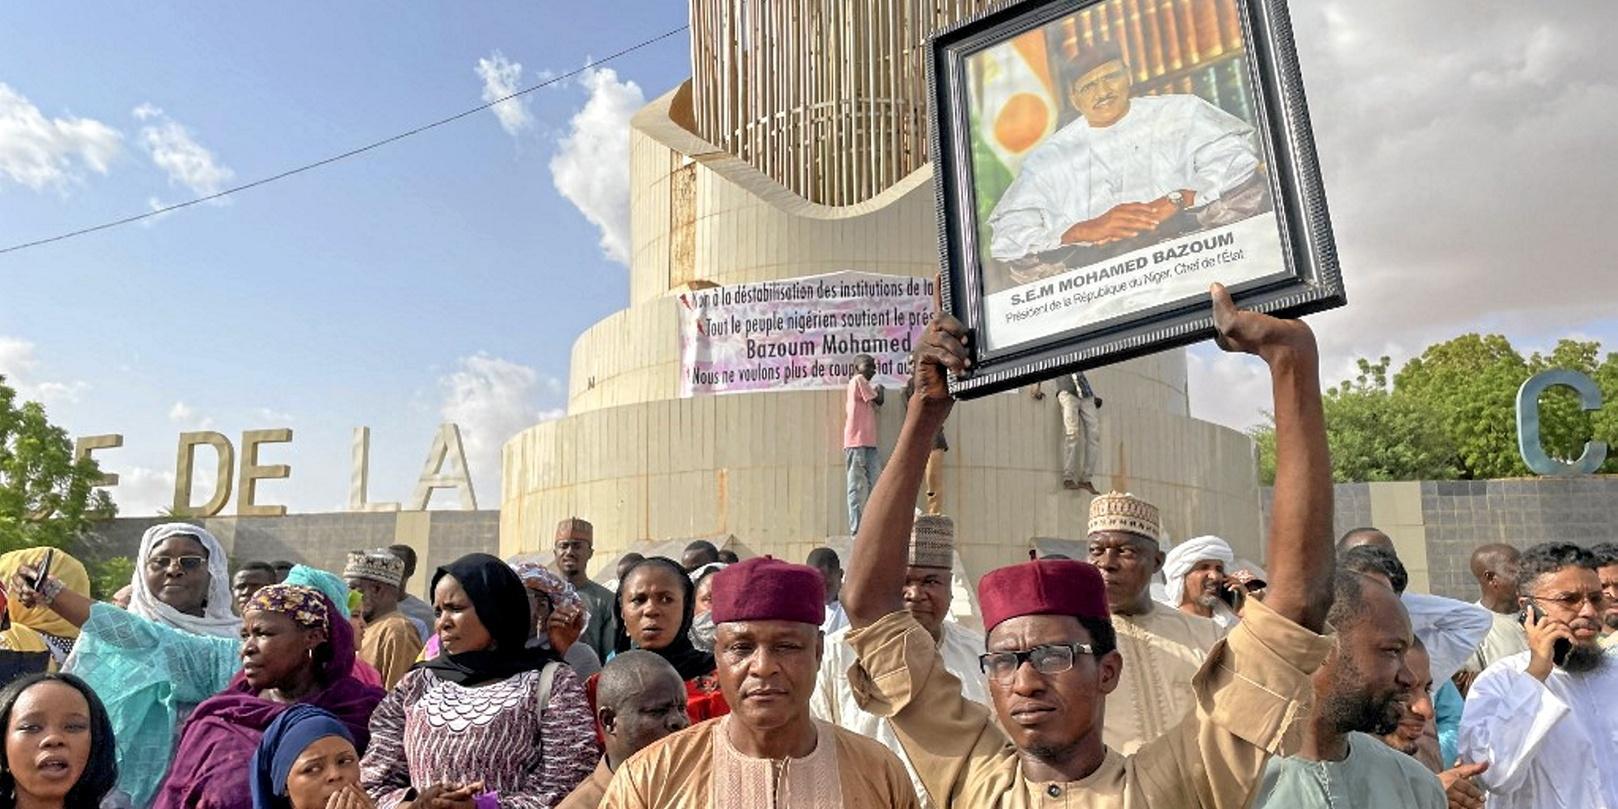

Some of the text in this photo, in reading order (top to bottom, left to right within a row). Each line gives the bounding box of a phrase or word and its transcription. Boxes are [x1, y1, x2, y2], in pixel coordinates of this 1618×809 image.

[1058, 257, 1148, 292] MOHAMED
[1152, 232, 1234, 264] BAZOUM
[712, 288, 719, 307] à
[722, 287, 731, 306] la
[735, 281, 814, 304] déstabilisation
[817, 279, 837, 299] des
[840, 279, 904, 298] institutions
[906, 277, 920, 296] de
[924, 278, 934, 296] la
[1005, 303, 1047, 323] Président
[1050, 300, 1061, 311] de
[1063, 298, 1072, 307] la
[1073, 281, 1127, 303] République
[1129, 277, 1142, 288] du
[1174, 260, 1200, 275] Chef
[1201, 257, 1215, 269] de
[706, 317, 728, 336] Tout
[731, 315, 741, 334] le
[746, 312, 783, 338] peuple
[787, 310, 837, 334] nigérien
[842, 308, 890, 328] soutient
[894, 307, 905, 326] le
[747, 331, 911, 360] Bazoum Mohamed
[692, 366, 719, 385] Nous
[722, 370, 734, 383] ne
[740, 362, 780, 382] voulons
[784, 360, 807, 384] plus
[811, 360, 825, 377] de
[173, 428, 293, 517] DE
[347, 422, 478, 512] LA
